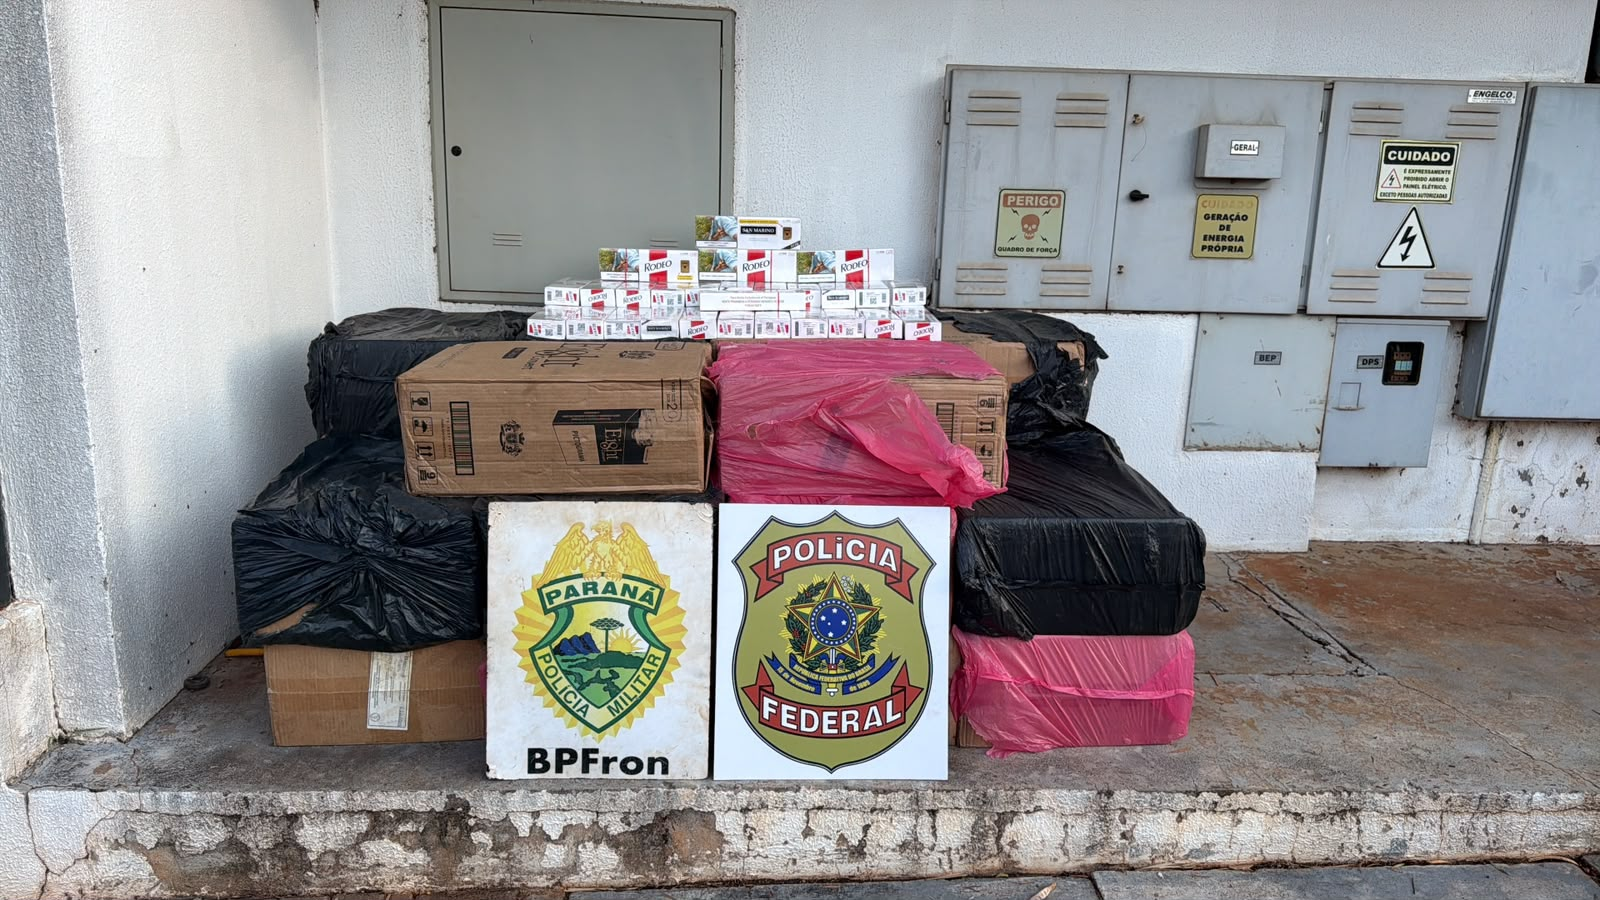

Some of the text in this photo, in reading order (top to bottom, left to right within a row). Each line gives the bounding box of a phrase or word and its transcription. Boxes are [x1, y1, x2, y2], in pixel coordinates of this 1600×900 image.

[1473, 90, 1513, 98] ENGELCO
[1387, 150, 1451, 162] CUIDADO
[1007, 195, 1059, 207] PERIGO
[1201, 200, 1254, 209] CUIDADO
[1203, 212, 1249, 223] GERAÇÃO
[1202, 234, 1245, 242] ENERGIA
[1201, 243, 1244, 253] PRÓPRIA
[644, 259, 673, 272] RODEO
[742, 259, 770, 272] RODEO
[840, 259, 869, 273] RODEO
[1258, 354, 1277, 362] BEP
[1361, 358, 1380, 366] DPS
[546, 581, 655, 606] PARANÁ
[607, 652, 662, 718] MILITAR
[762, 695, 903, 735] FEDERAL
[527, 747, 669, 776] BPFron
